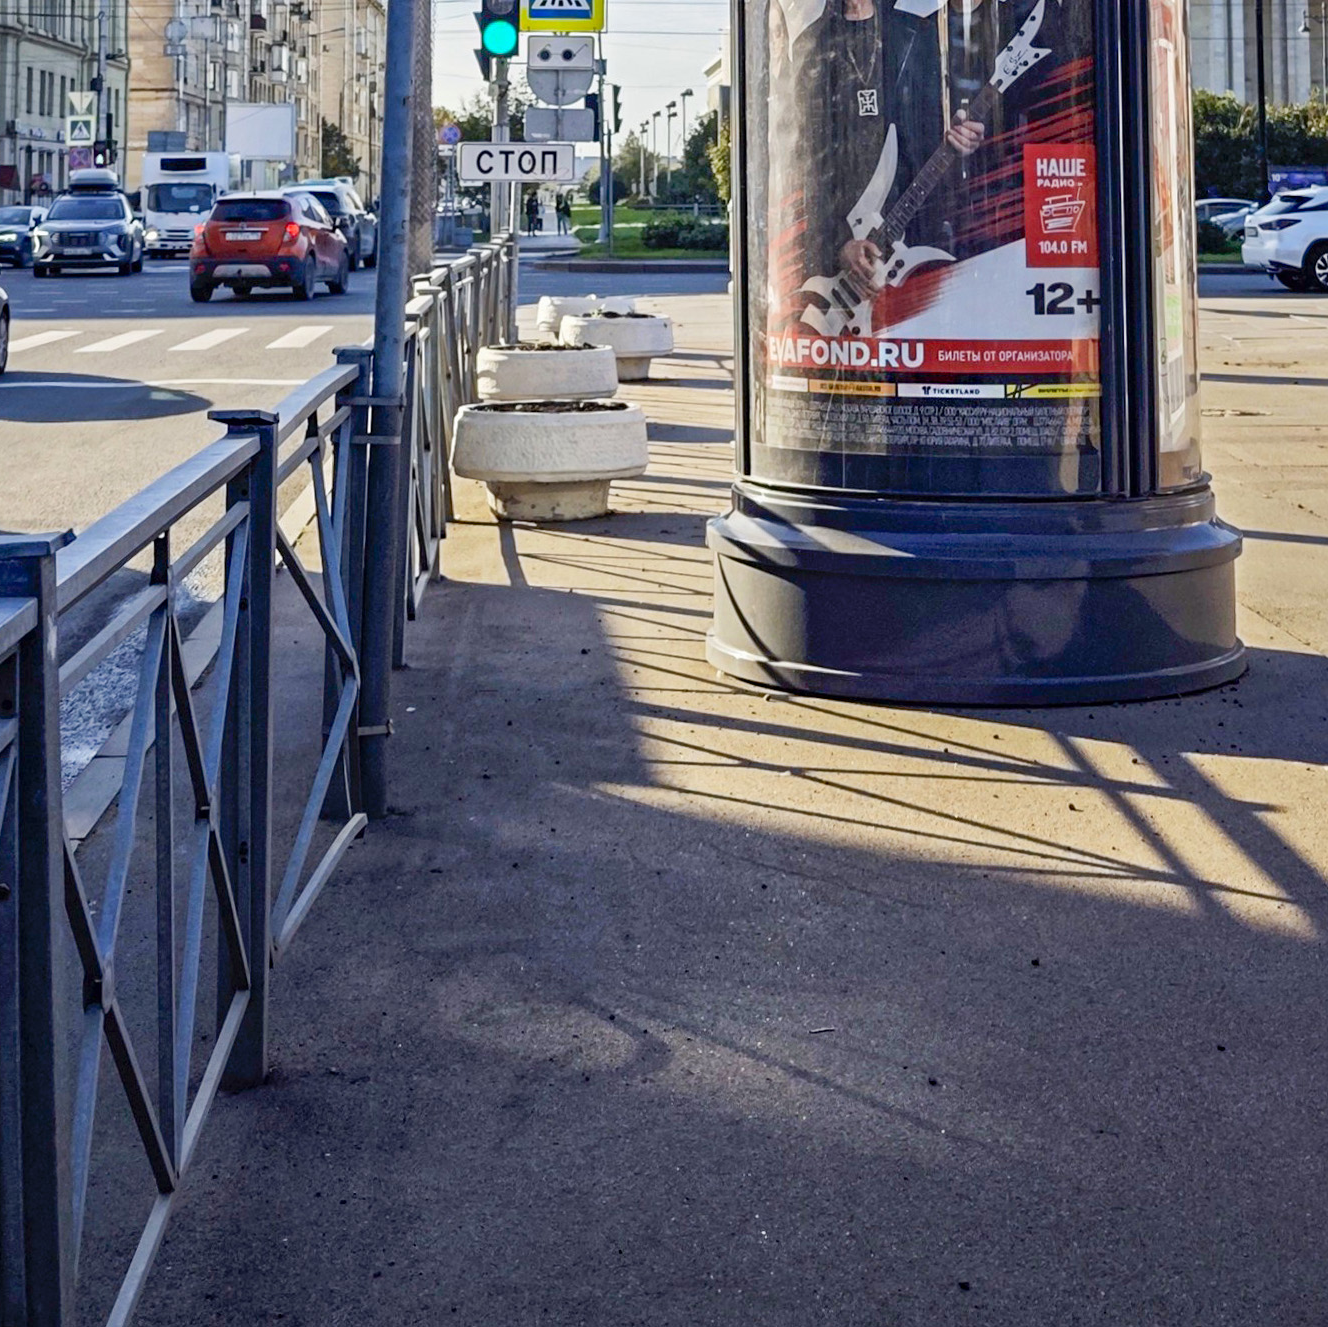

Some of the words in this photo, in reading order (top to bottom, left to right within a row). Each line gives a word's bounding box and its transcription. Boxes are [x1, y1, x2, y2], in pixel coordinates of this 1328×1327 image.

[476, 149, 558, 175] СТОП
[1036, 158, 1087, 177] НАШЕ
[1037, 179, 1075, 188] РАДИО
[1038, 241, 1068, 254] 104.0
[1071, 241, 1088, 254] FM
[1026, 282, 1101, 315] 12+
[938, 350, 981, 362] БИЛЕТЫ
[983, 351, 996, 362] ОТ
[999, 351, 1074, 362] ОРГАНИЗАТОРА
